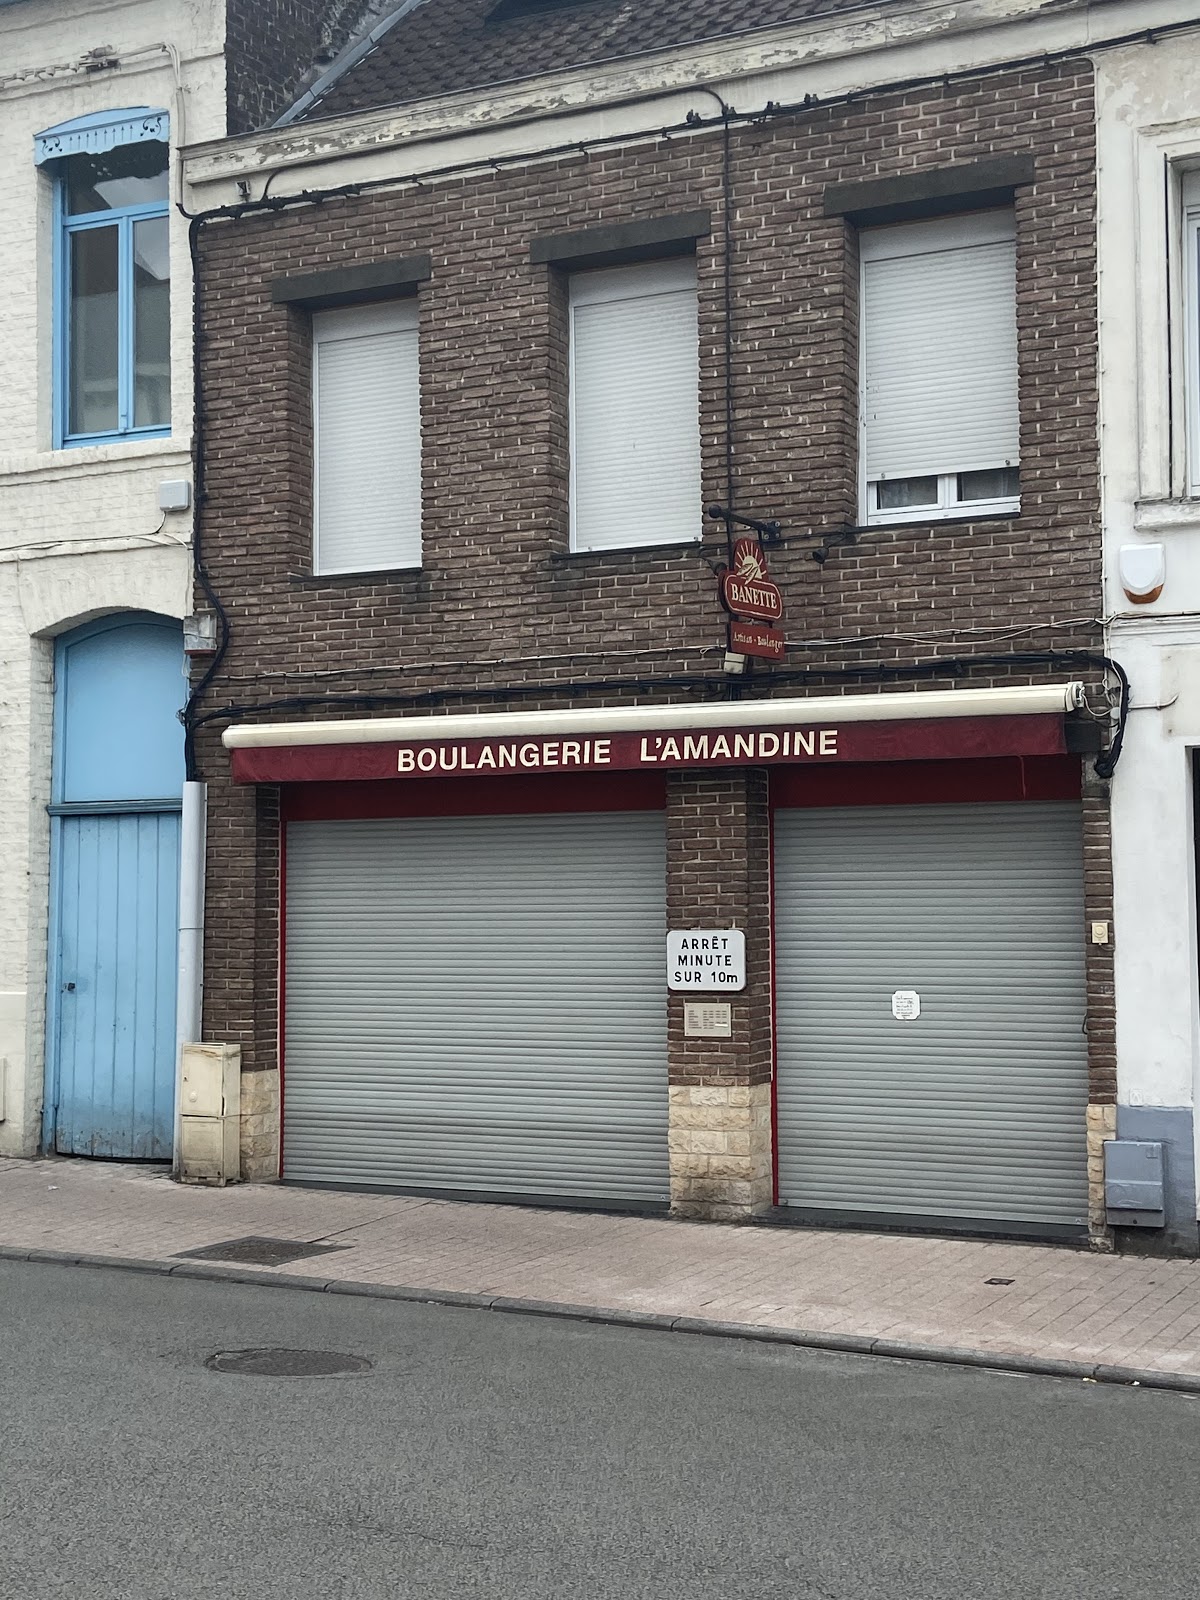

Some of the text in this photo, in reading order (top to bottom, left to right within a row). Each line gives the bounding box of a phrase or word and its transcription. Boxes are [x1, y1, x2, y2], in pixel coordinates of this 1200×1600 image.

[731, 583, 777, 609] BANETTE
[397, 730, 838, 772] BOULANGERIE L'AMANDINE
[681, 936, 728, 950] ARRÊT
[678, 955, 732, 966] MINUTE
[674, 971, 738, 983] SUR 10m
